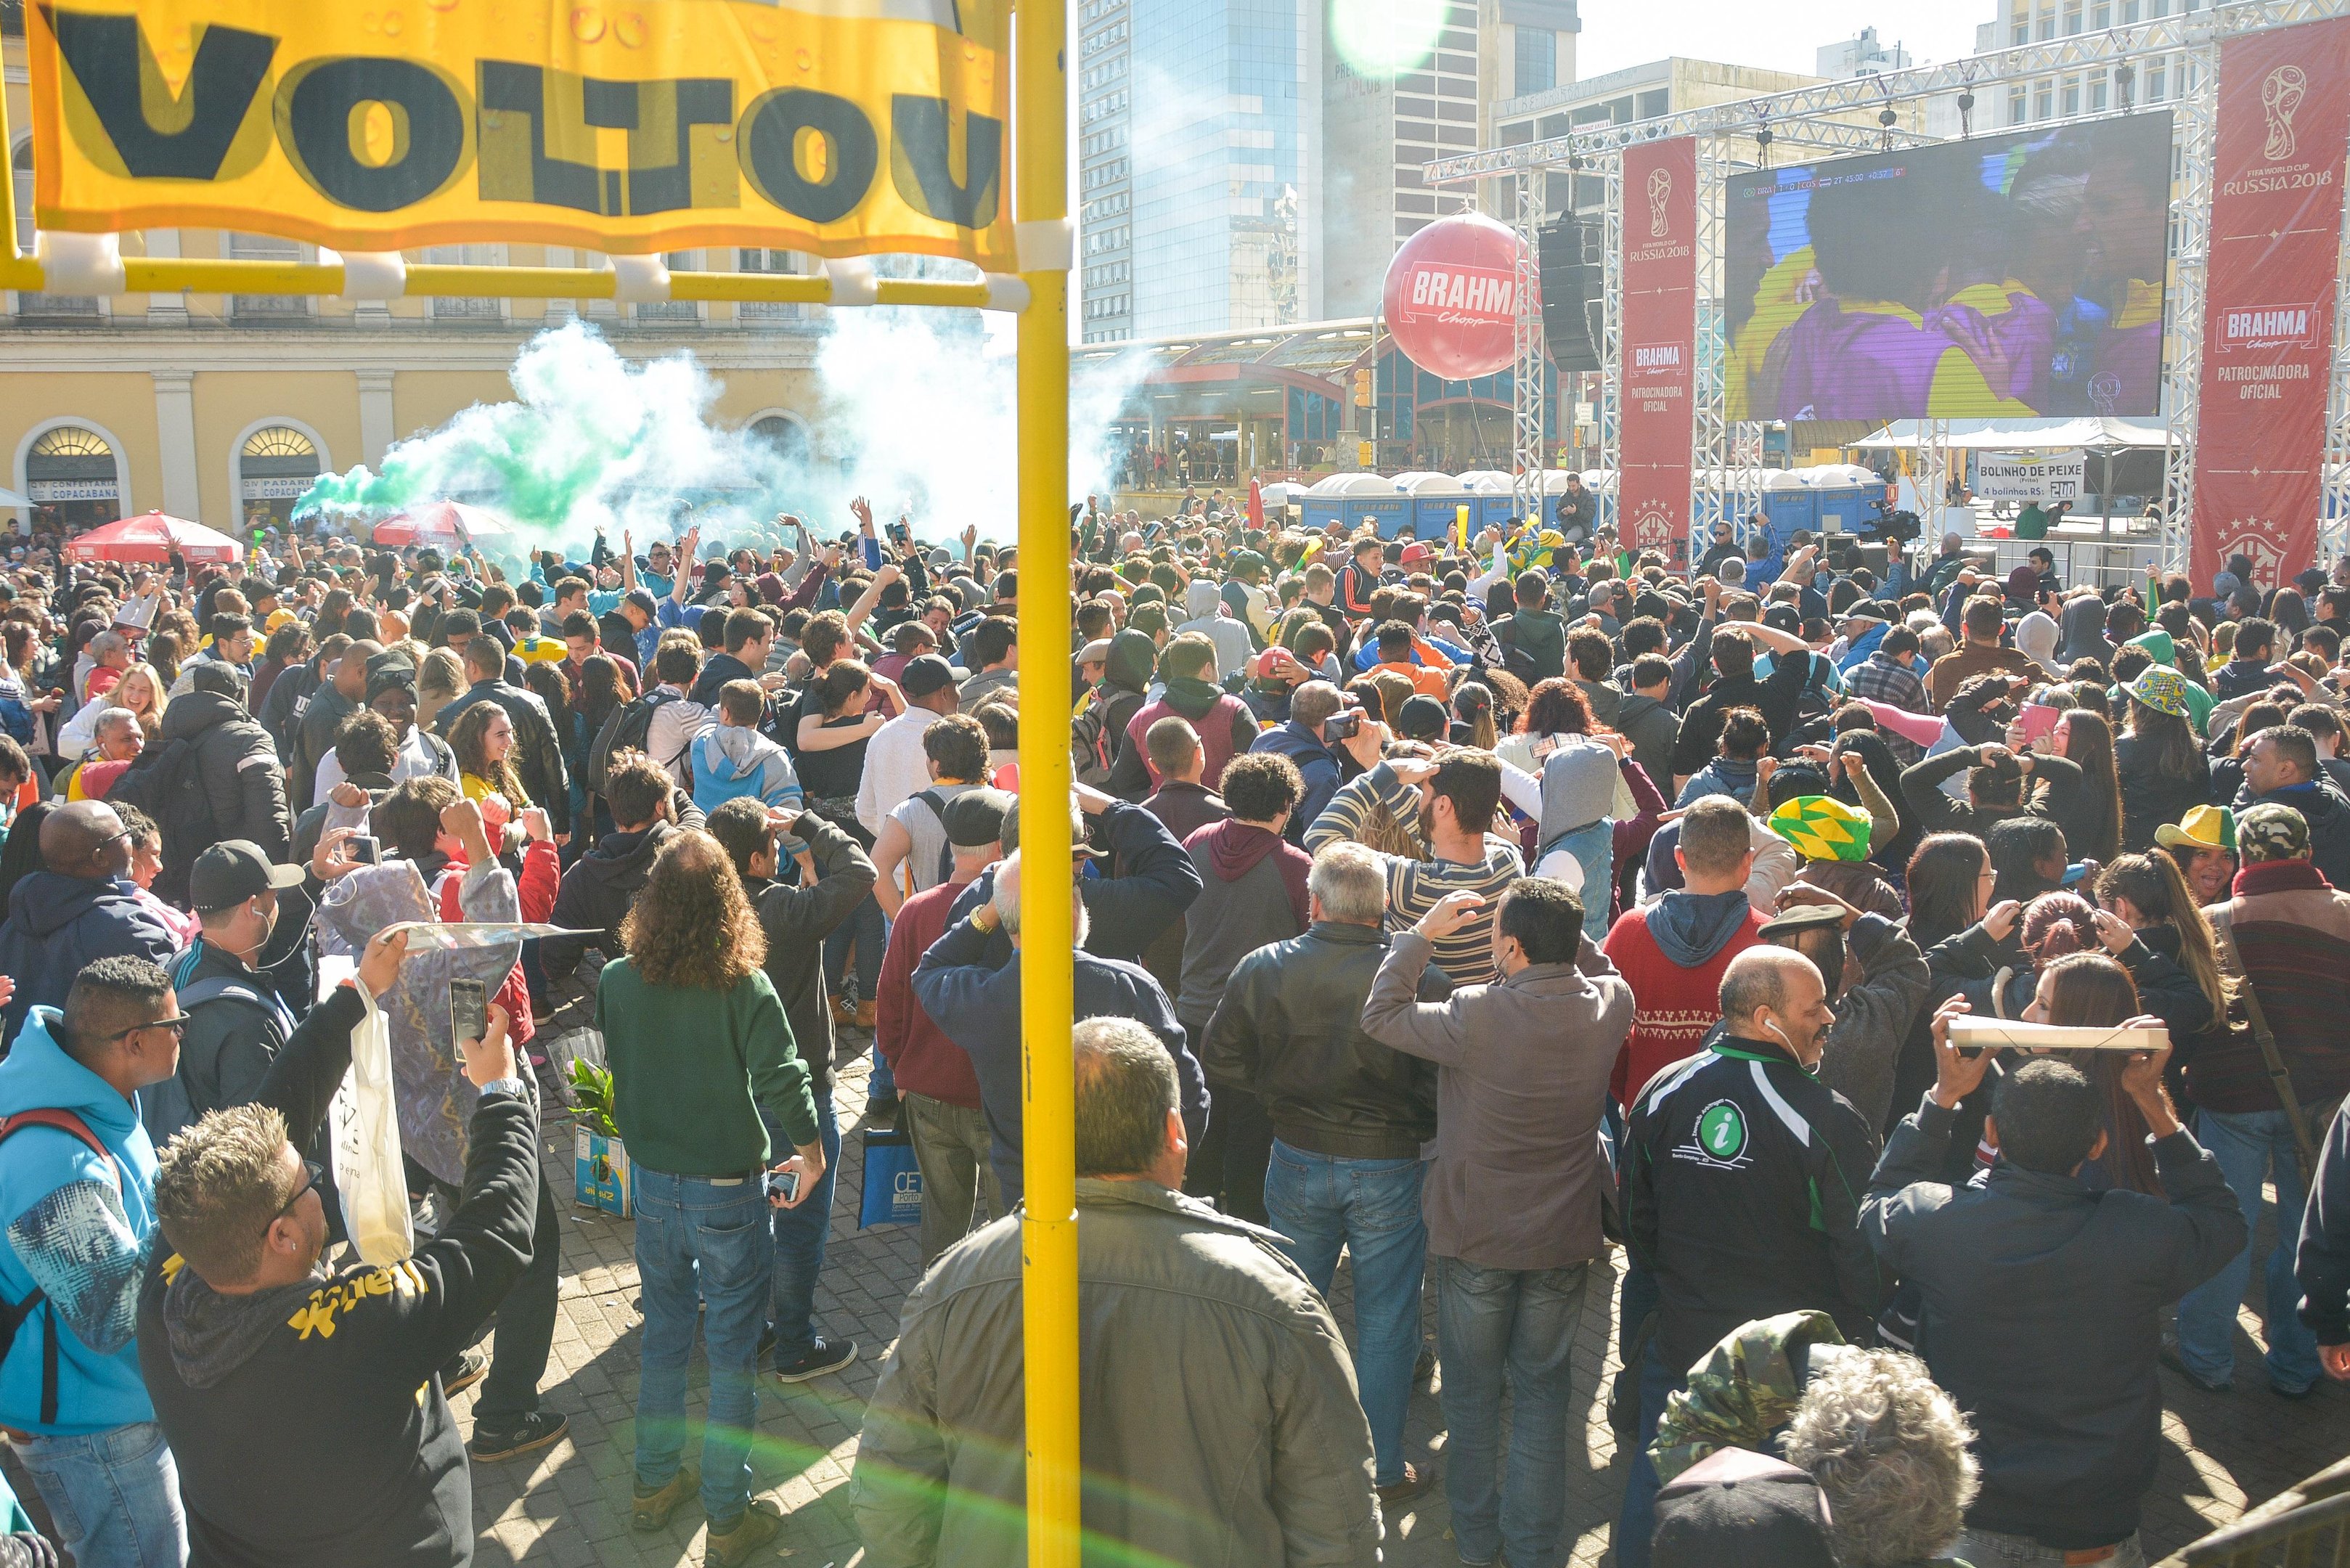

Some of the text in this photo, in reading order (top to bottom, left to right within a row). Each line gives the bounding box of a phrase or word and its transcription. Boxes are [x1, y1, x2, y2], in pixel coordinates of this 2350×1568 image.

[2264, 166, 2293, 175] WORLD
[2294, 163, 2310, 171] CUP
[2224, 171, 2333, 196] RUSSIA 2018
[1630, 245, 1689, 262] RUSSIA 2018
[1437, 311, 1499, 327] Chopp
[2227, 310, 2306, 338] BRAHMA
[2246, 340, 2288, 348] Chopp
[1636, 346, 1680, 367] BRAHMA
[2218, 364, 2309, 381] PATROCINADORA
[1631, 386, 1683, 399] PATROCINADORA
[2240, 384, 2281, 399] OFICIAL
[1643, 401, 1668, 412] OFICIAL
[1980, 465, 2082, 477] BOLINHO DE PEIXE
[53, 489, 118, 499] COPACABANA
[1992, 487, 2028, 496] bolinhos
[899, 1193, 919, 1202] Porto
